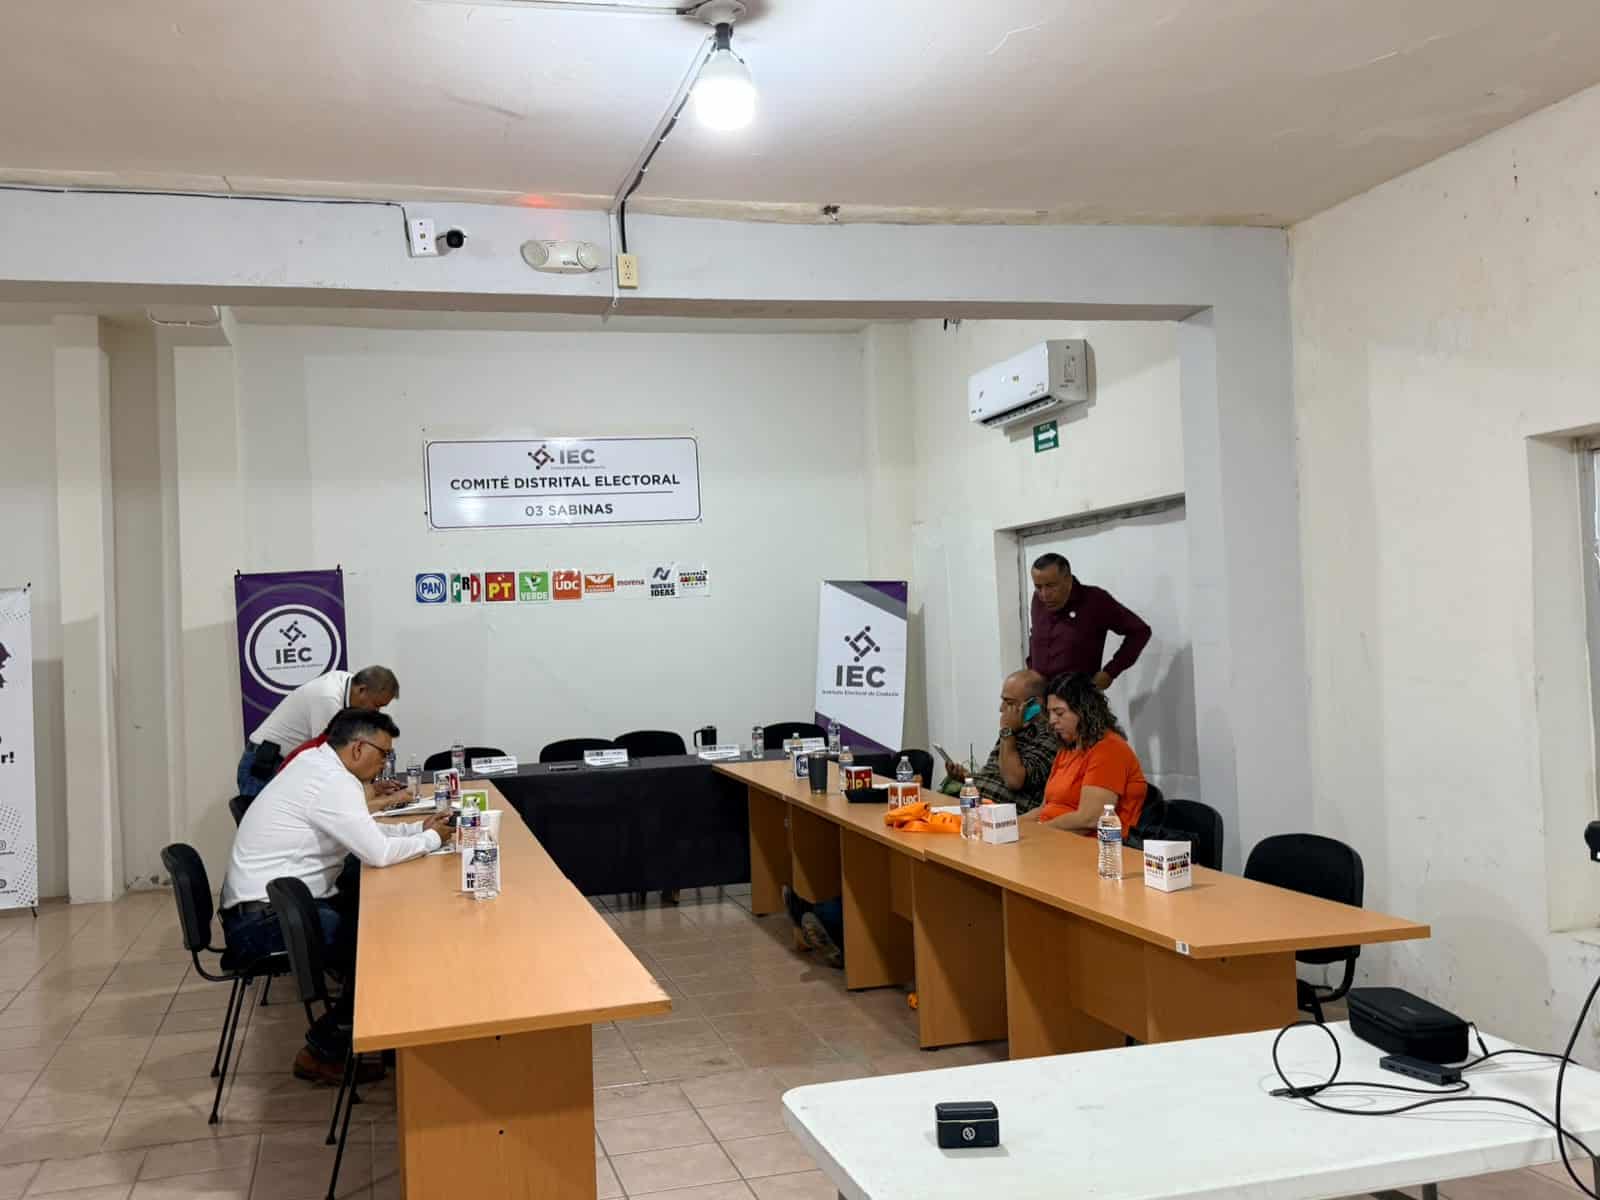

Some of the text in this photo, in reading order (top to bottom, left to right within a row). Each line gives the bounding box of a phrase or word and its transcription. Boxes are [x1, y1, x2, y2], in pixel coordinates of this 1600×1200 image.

[559, 449, 595, 464] IEC
[450, 474, 681, 490] COMITÉ DISTRITAL ELECTORAL
[525, 503, 613, 517] 03 SABINAS
[421, 582, 440, 595] PAN
[453, 576, 478, 596] PRI
[488, 582, 512, 598] PT
[651, 589, 675, 597] IDEAS
[520, 592, 548, 600] VERDE
[275, 647, 312, 664] IEC
[836, 665, 885, 688] IEC
[855, 779, 872, 789] PT
